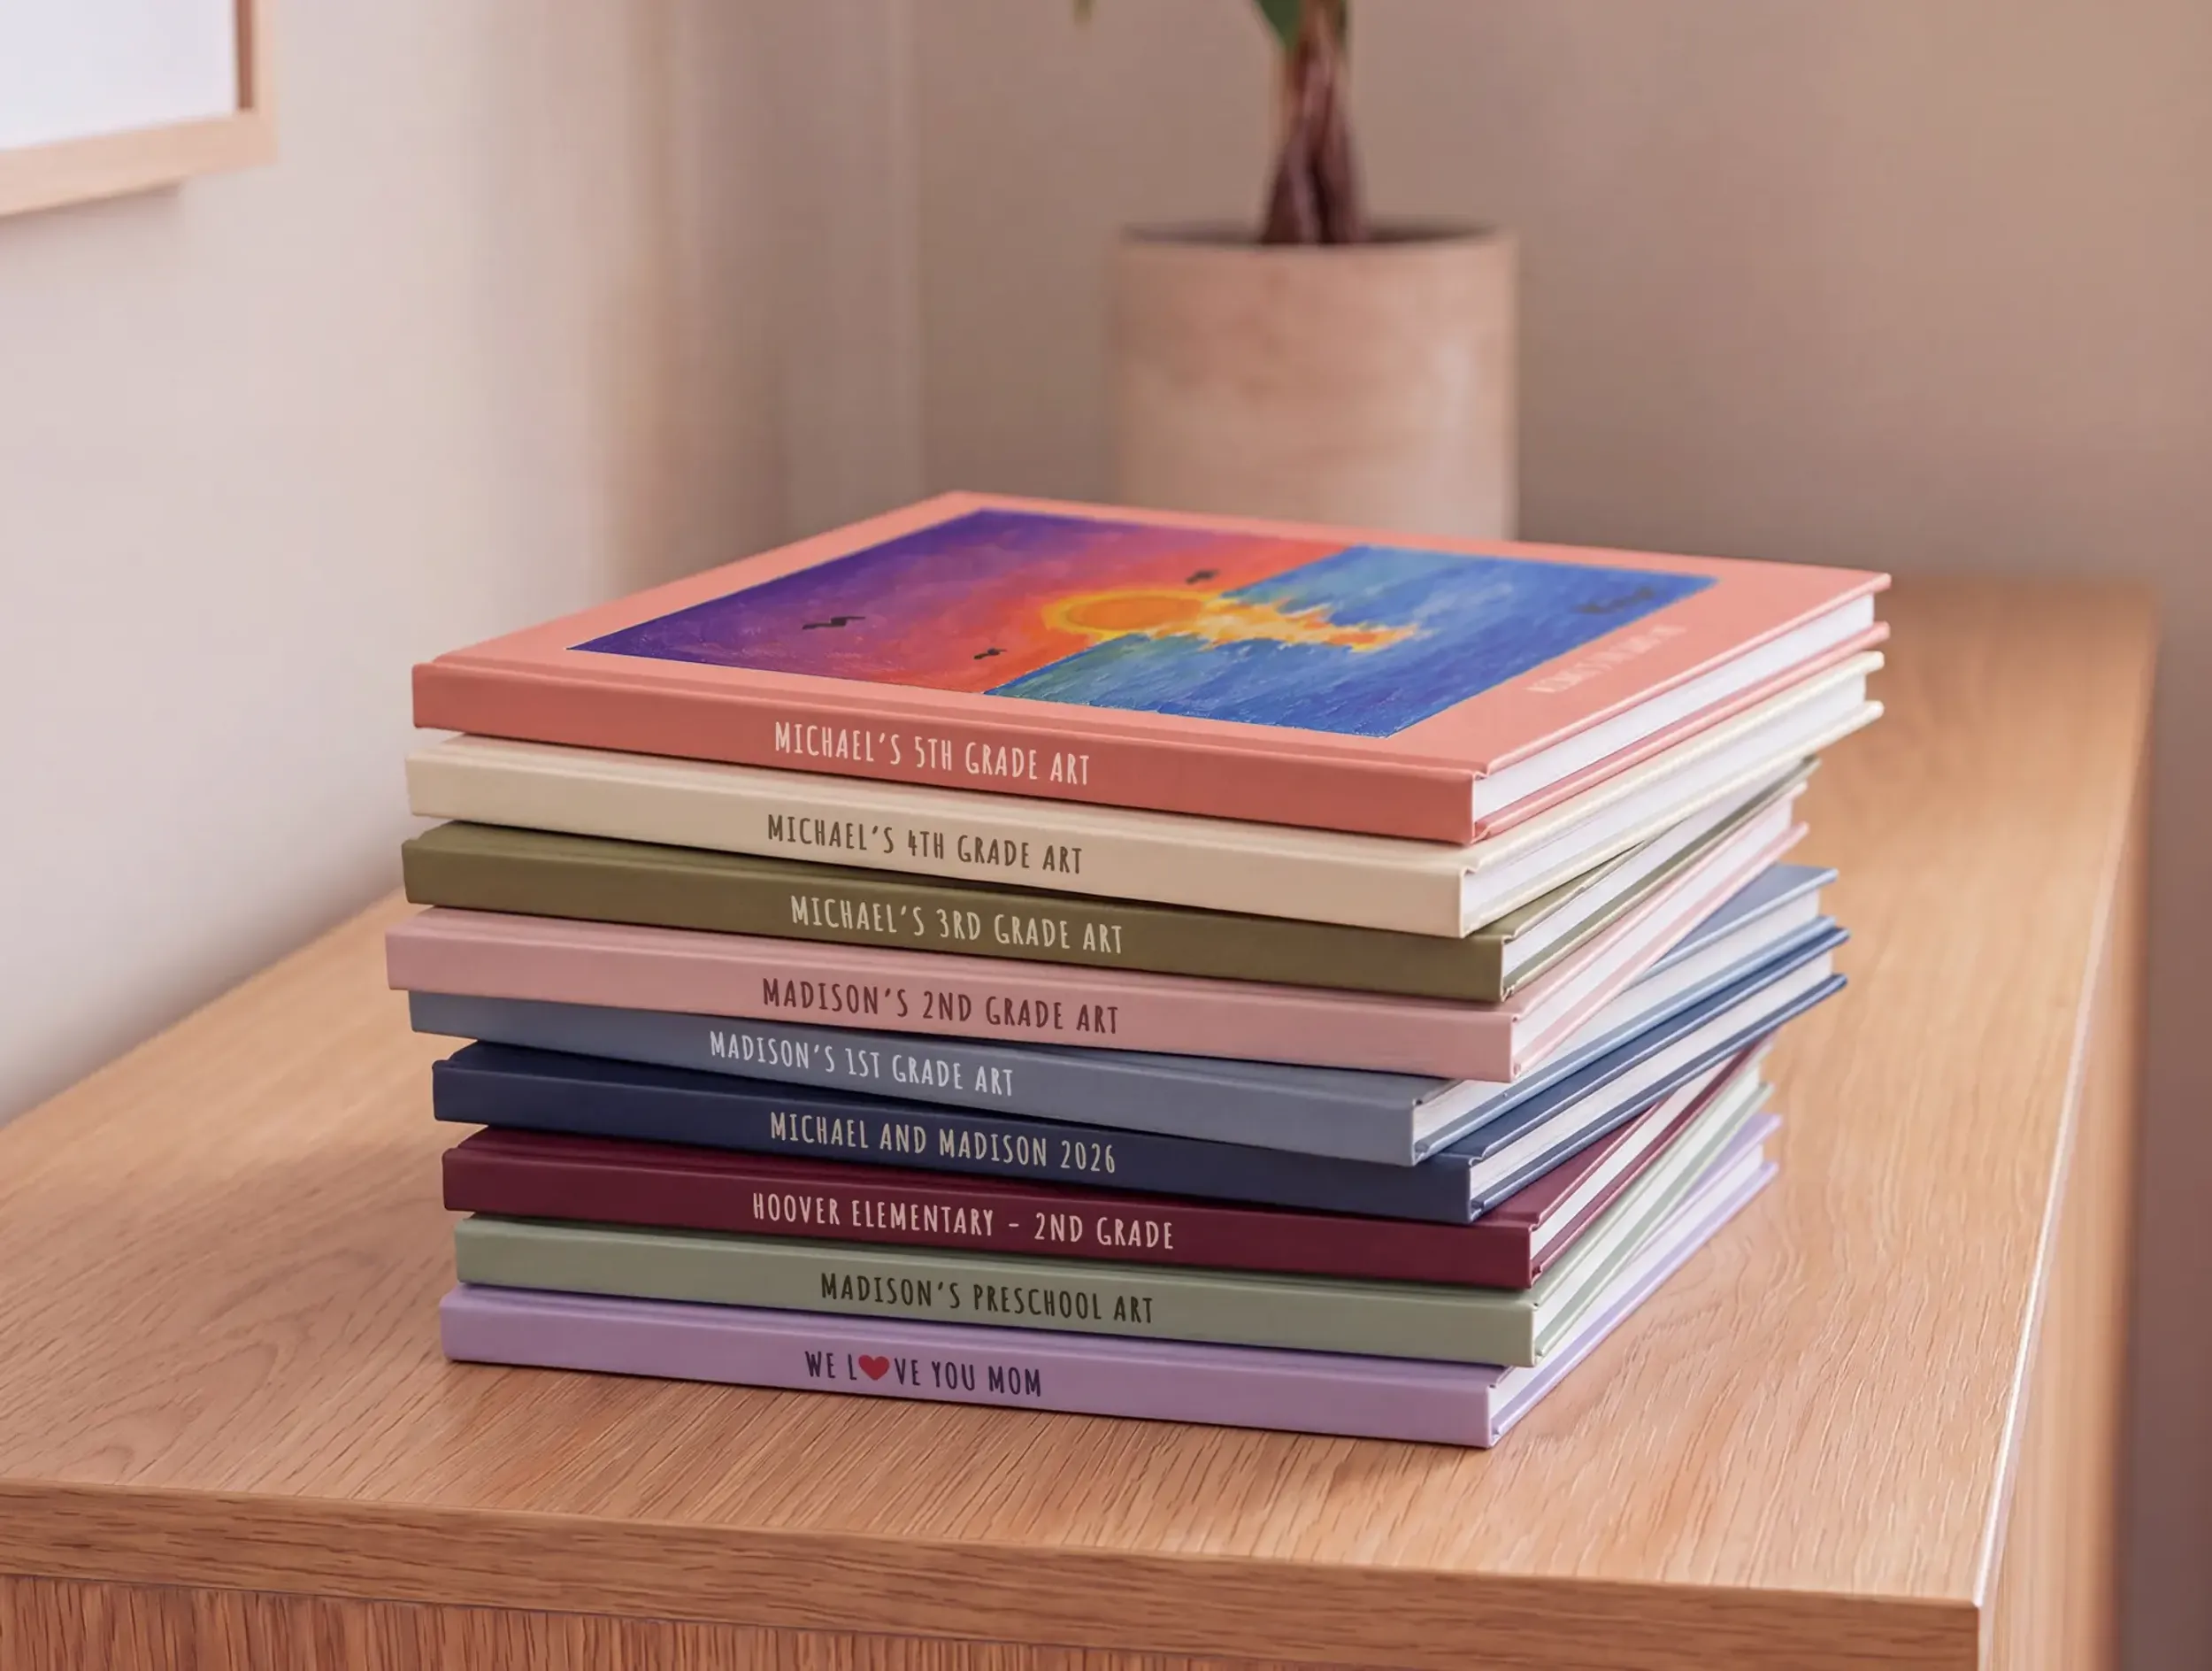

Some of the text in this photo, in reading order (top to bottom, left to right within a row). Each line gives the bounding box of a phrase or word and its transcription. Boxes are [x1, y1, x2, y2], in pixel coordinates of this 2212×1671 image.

[775, 721, 1090, 786] MICHAEL'S 5TH GRADE ART
[767, 813, 1083, 875] MICHAEL'S 4TH GRADE ART
[790, 895, 1123, 954] MICHAEL'S 3RD GRADE ART
[762, 978, 1118, 1034] MADISON'S 2ND GRADE ART
[709, 1030, 1014, 1097] MADISON'S 1ST GRADE ART
[769, 1112, 1117, 1174] MICHAEL AND MADISON 2026
[752, 1192, 841, 1226] HOOVER
[851, 1199, 994, 1237] ELEMENTARY
[1033, 1212, 1083, 1244] 2ND
[1096, 1216, 1174, 1250] GRADE
[820, 1272, 1154, 1324] MADISON'S PRESCHOOL ART
[803, 1350, 835, 1380] WE
[931, 1361, 976, 1391] YOU
[987, 1366, 1042, 1398] MOM
